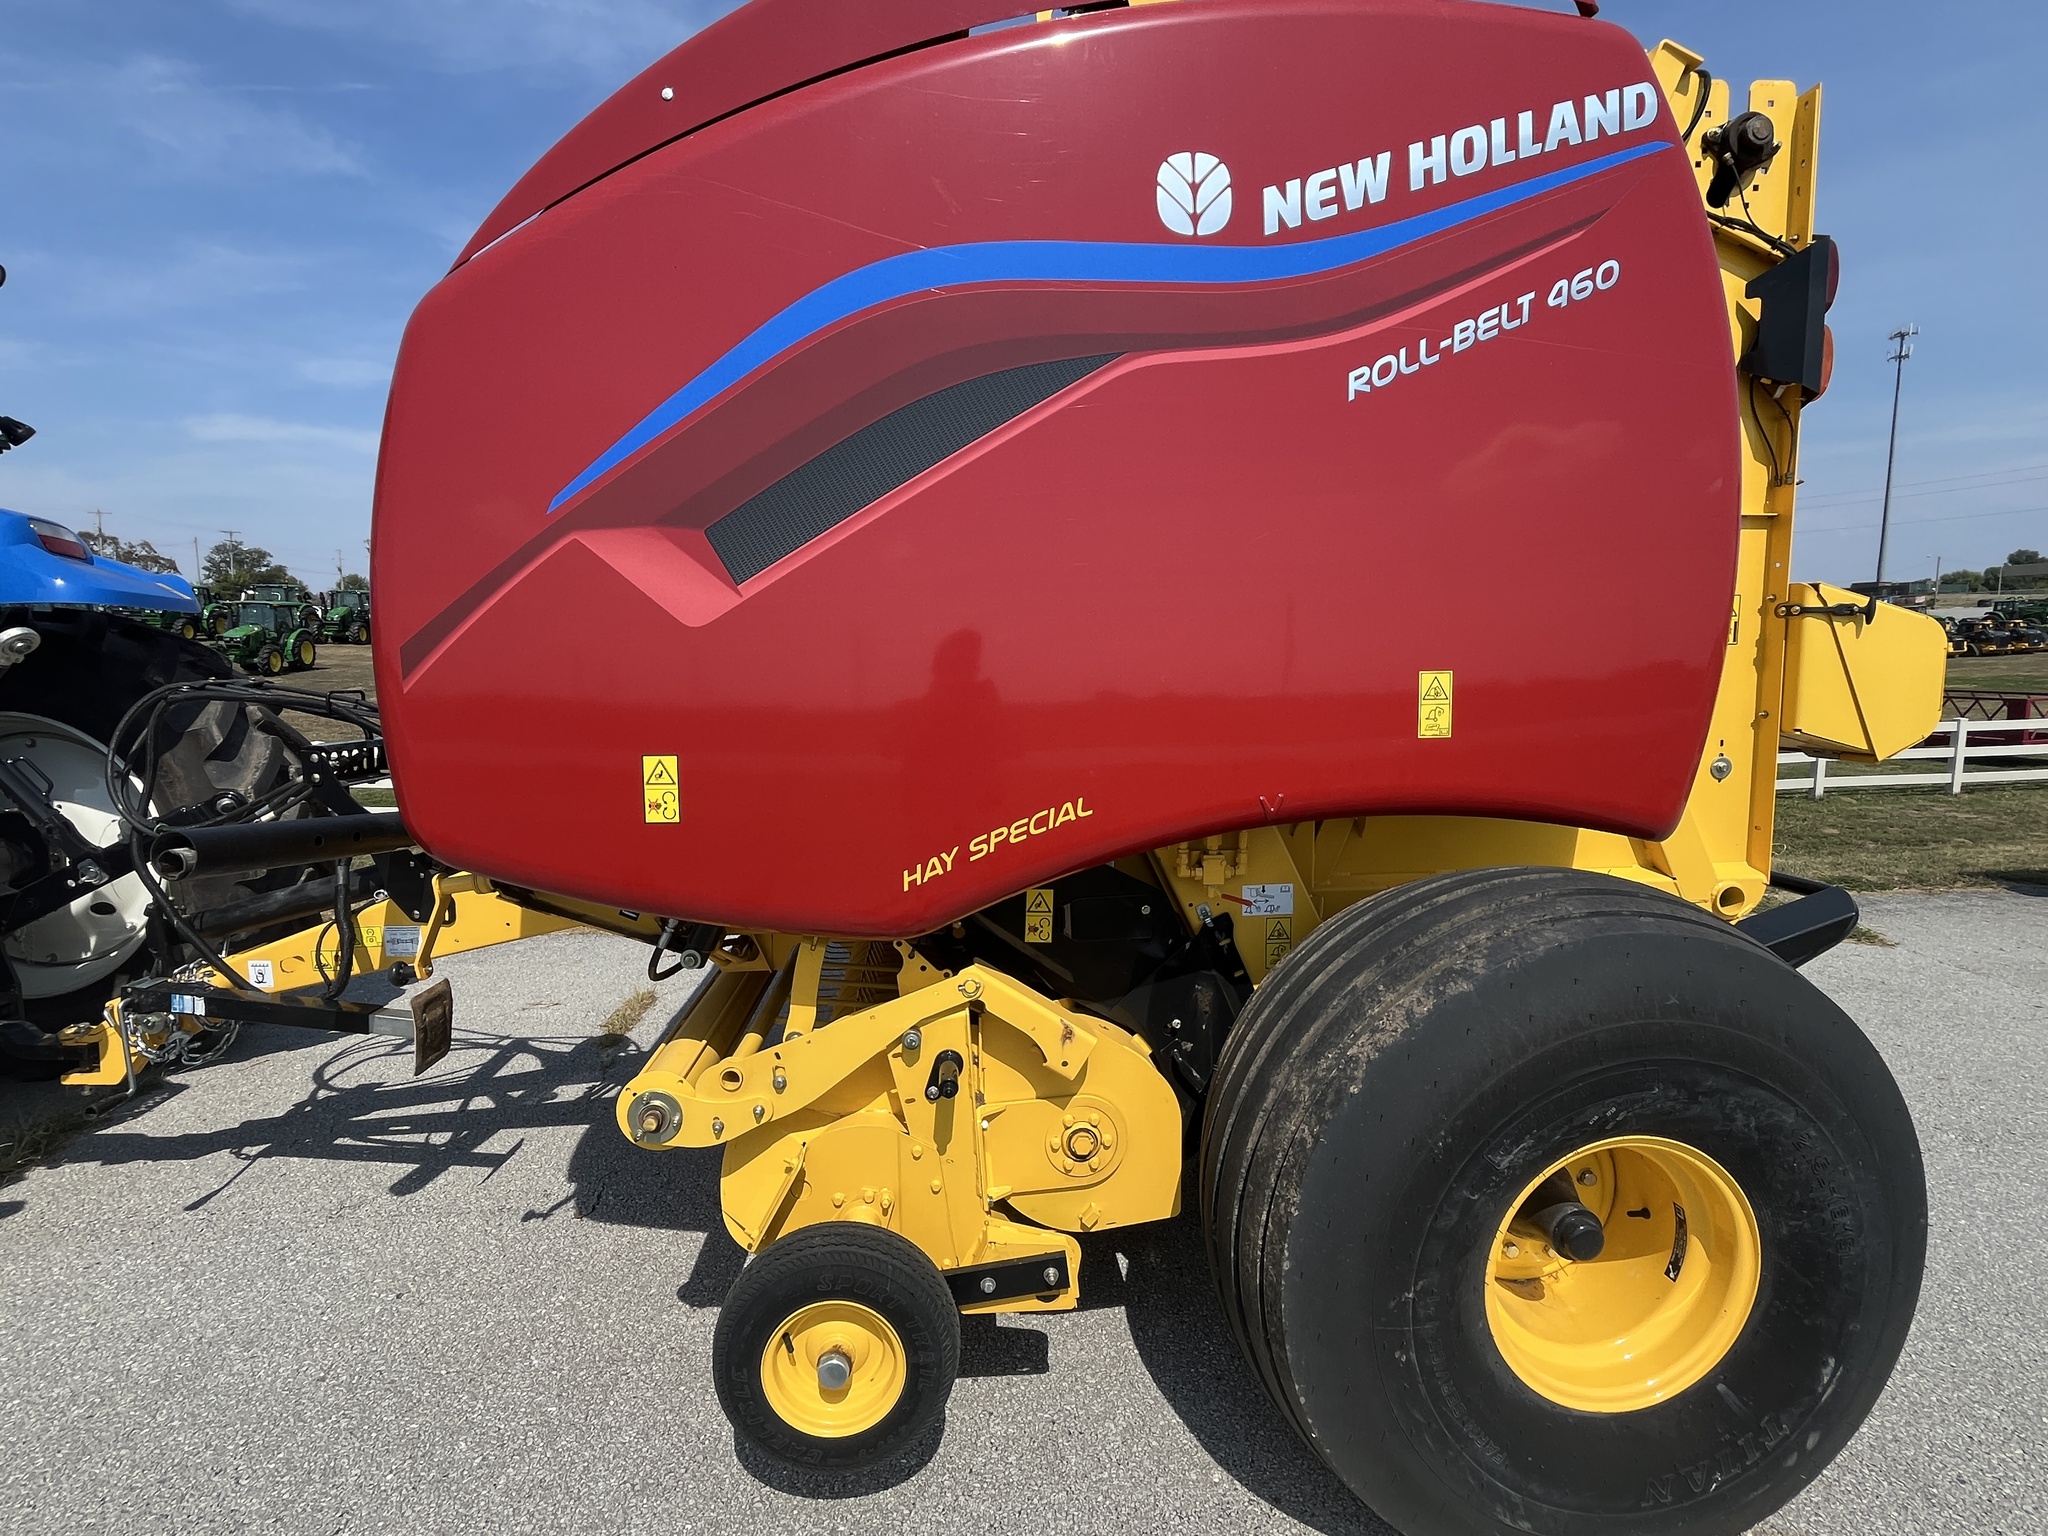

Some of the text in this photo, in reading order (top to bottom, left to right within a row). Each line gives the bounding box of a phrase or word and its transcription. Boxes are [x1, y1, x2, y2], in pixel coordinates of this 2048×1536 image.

[1263, 81, 1659, 235] NEW HOLLAND
[1348, 259, 1620, 401] ROLL-BELT 460
[903, 797, 1093, 891] HAY SPECIAL
[817, 1273, 938, 1391] SPORT TRAIL
[1428, 1337, 1469, 1418] SERVICE
[730, 1367, 822, 1464] CARLISLE
[1640, 1415, 1791, 1507] TITAN
